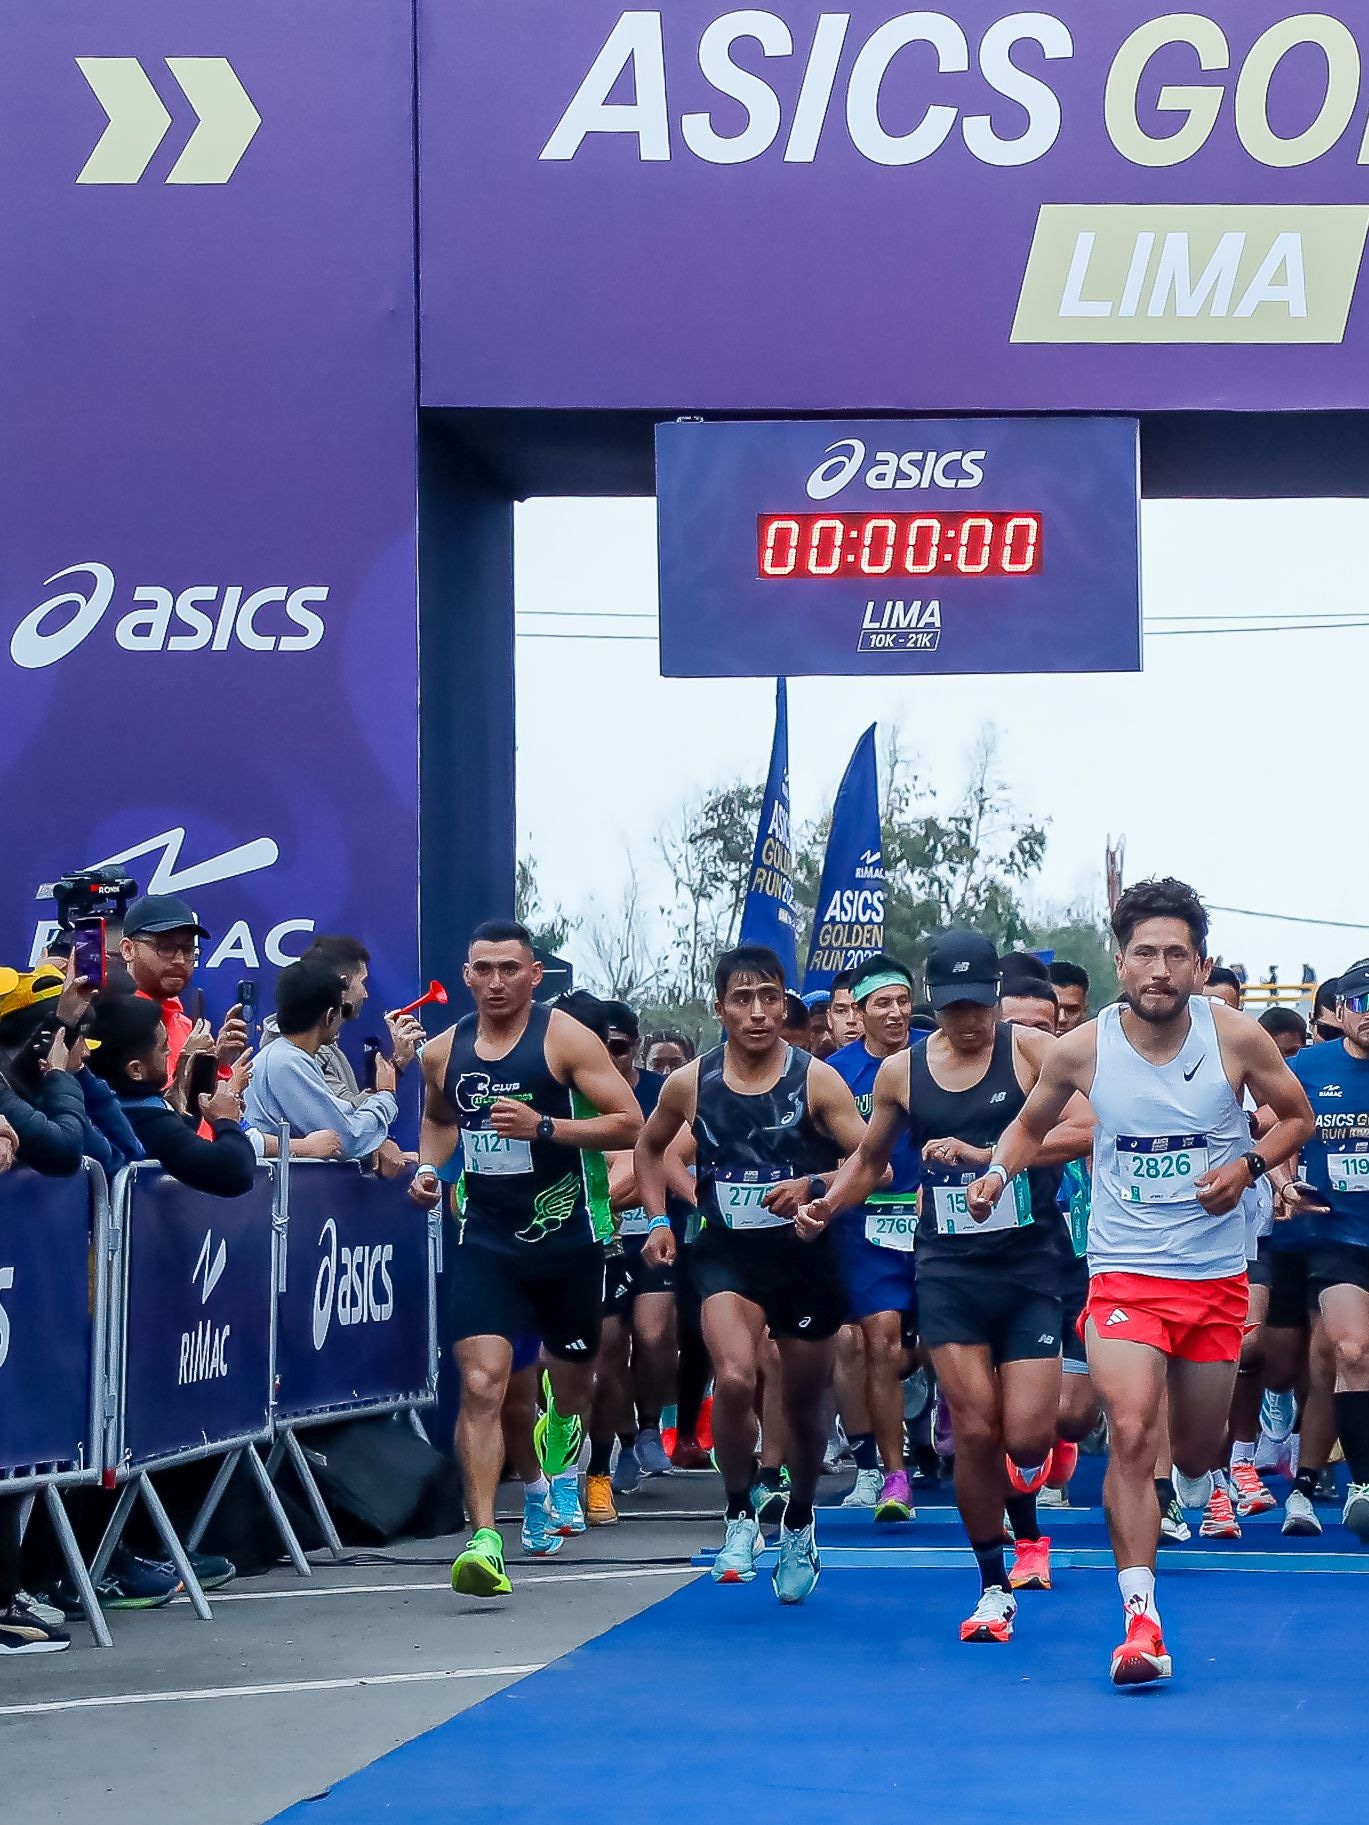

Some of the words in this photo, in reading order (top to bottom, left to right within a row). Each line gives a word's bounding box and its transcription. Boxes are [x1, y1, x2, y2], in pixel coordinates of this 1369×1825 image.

[538, 10, 1074, 167] ASICS
[1058, 231, 1309, 319] LIMA
[866, 449, 987, 490] asics
[762, 517, 1039, 576] 00:00:00
[114, 585, 330, 651] asics
[862, 599, 942, 629] LIMA
[823, 889, 884, 923] ASICS
[819, 924, 884, 948] GOLDEN
[810, 950, 845, 971] RUN
[1315, 1113, 1356, 1128] ASICS
[1321, 1128, 1346, 1140] RUN
[1132, 1153, 1192, 1179] 2826
[178, 1319, 231, 1385] RIMAC
